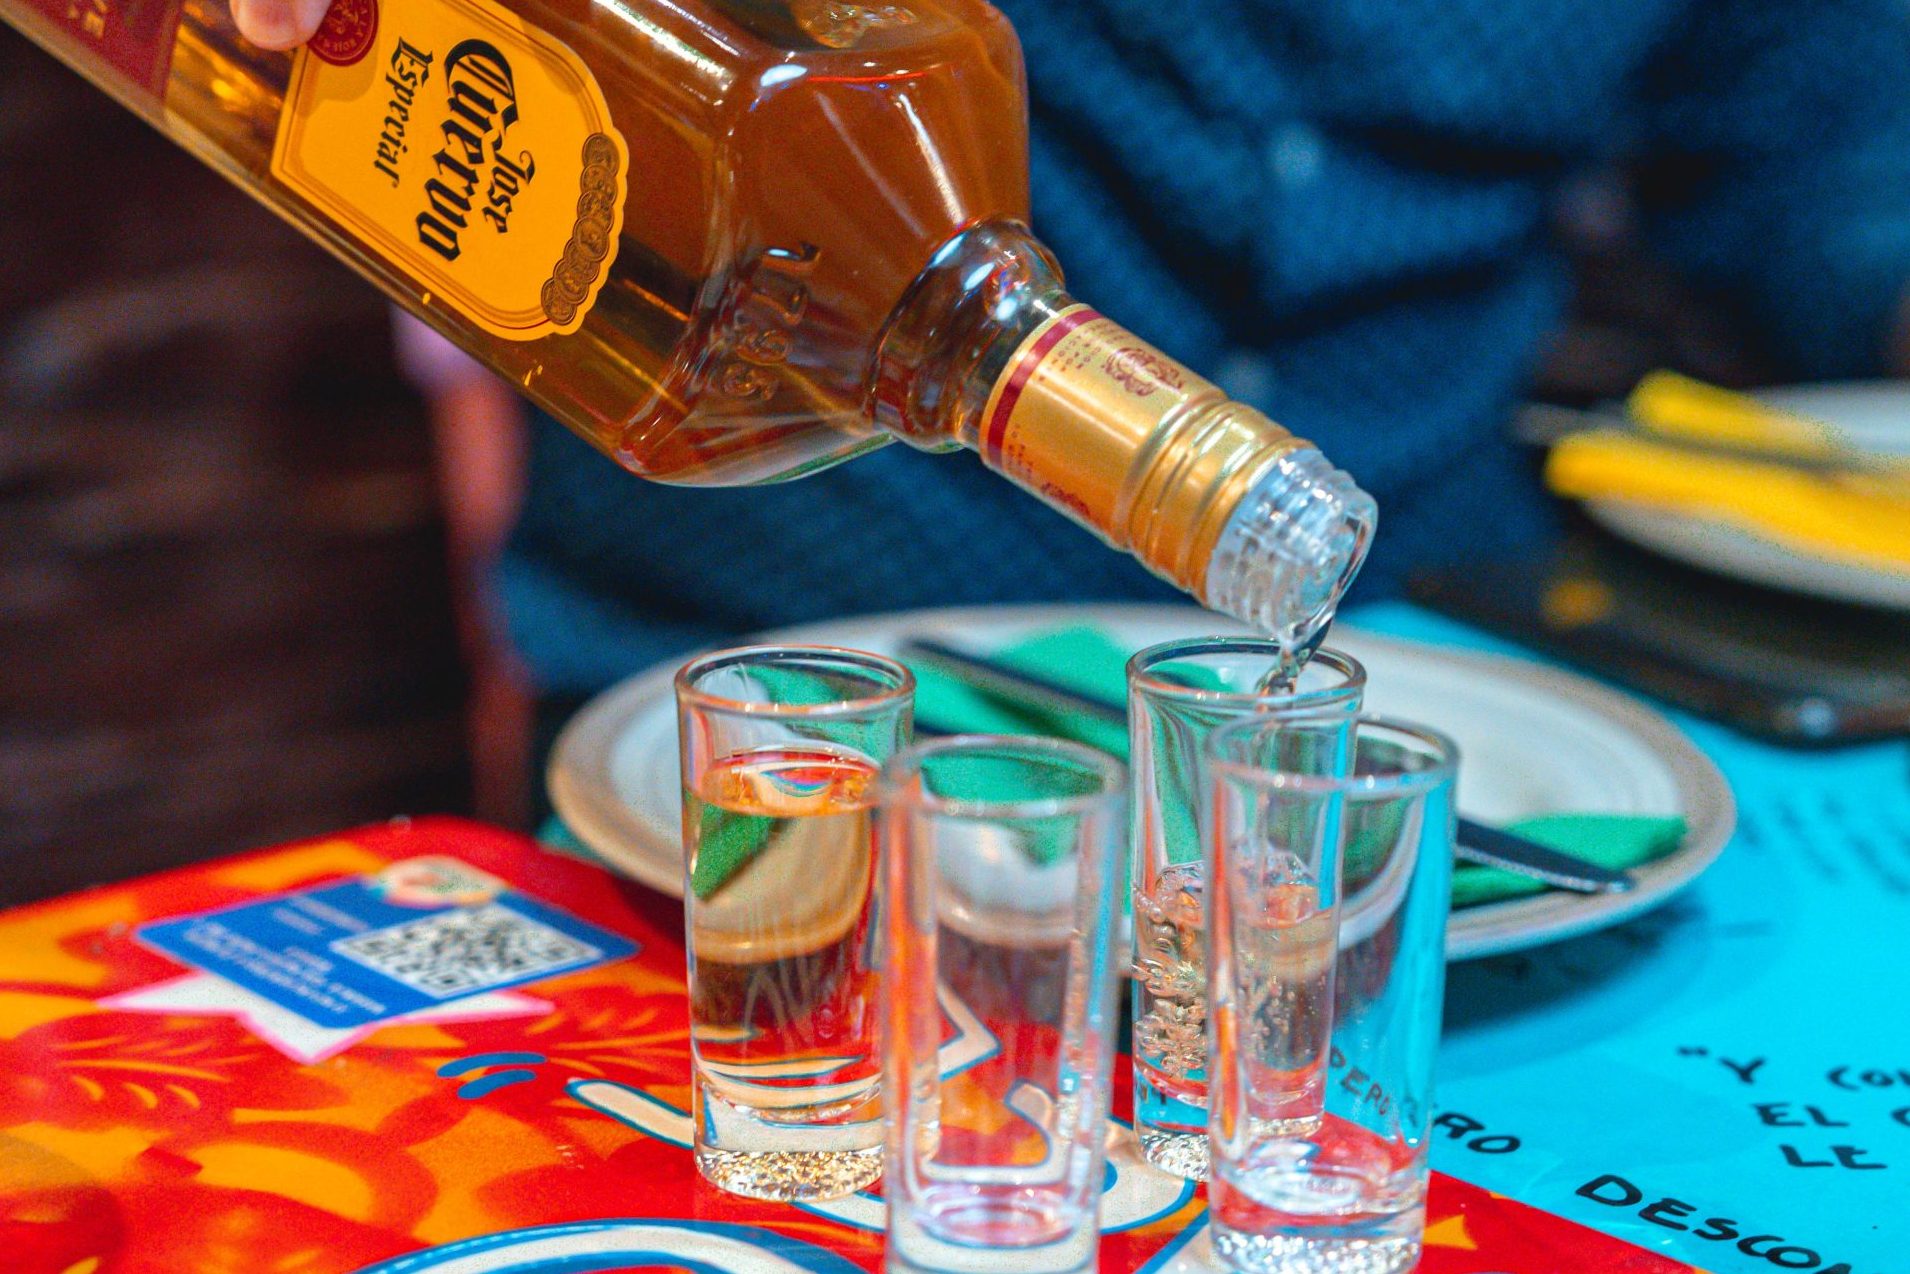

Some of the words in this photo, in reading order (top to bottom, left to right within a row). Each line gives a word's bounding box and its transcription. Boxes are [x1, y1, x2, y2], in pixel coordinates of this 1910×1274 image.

[373, 36, 434, 189] Especial
[415, 38, 519, 262] Cuervo
[482, 149, 536, 234] Jose
[1750, 1101, 1851, 1128] EL
[1777, 1143, 1889, 1170] LE
[1574, 1174, 1853, 1274] DESCO
